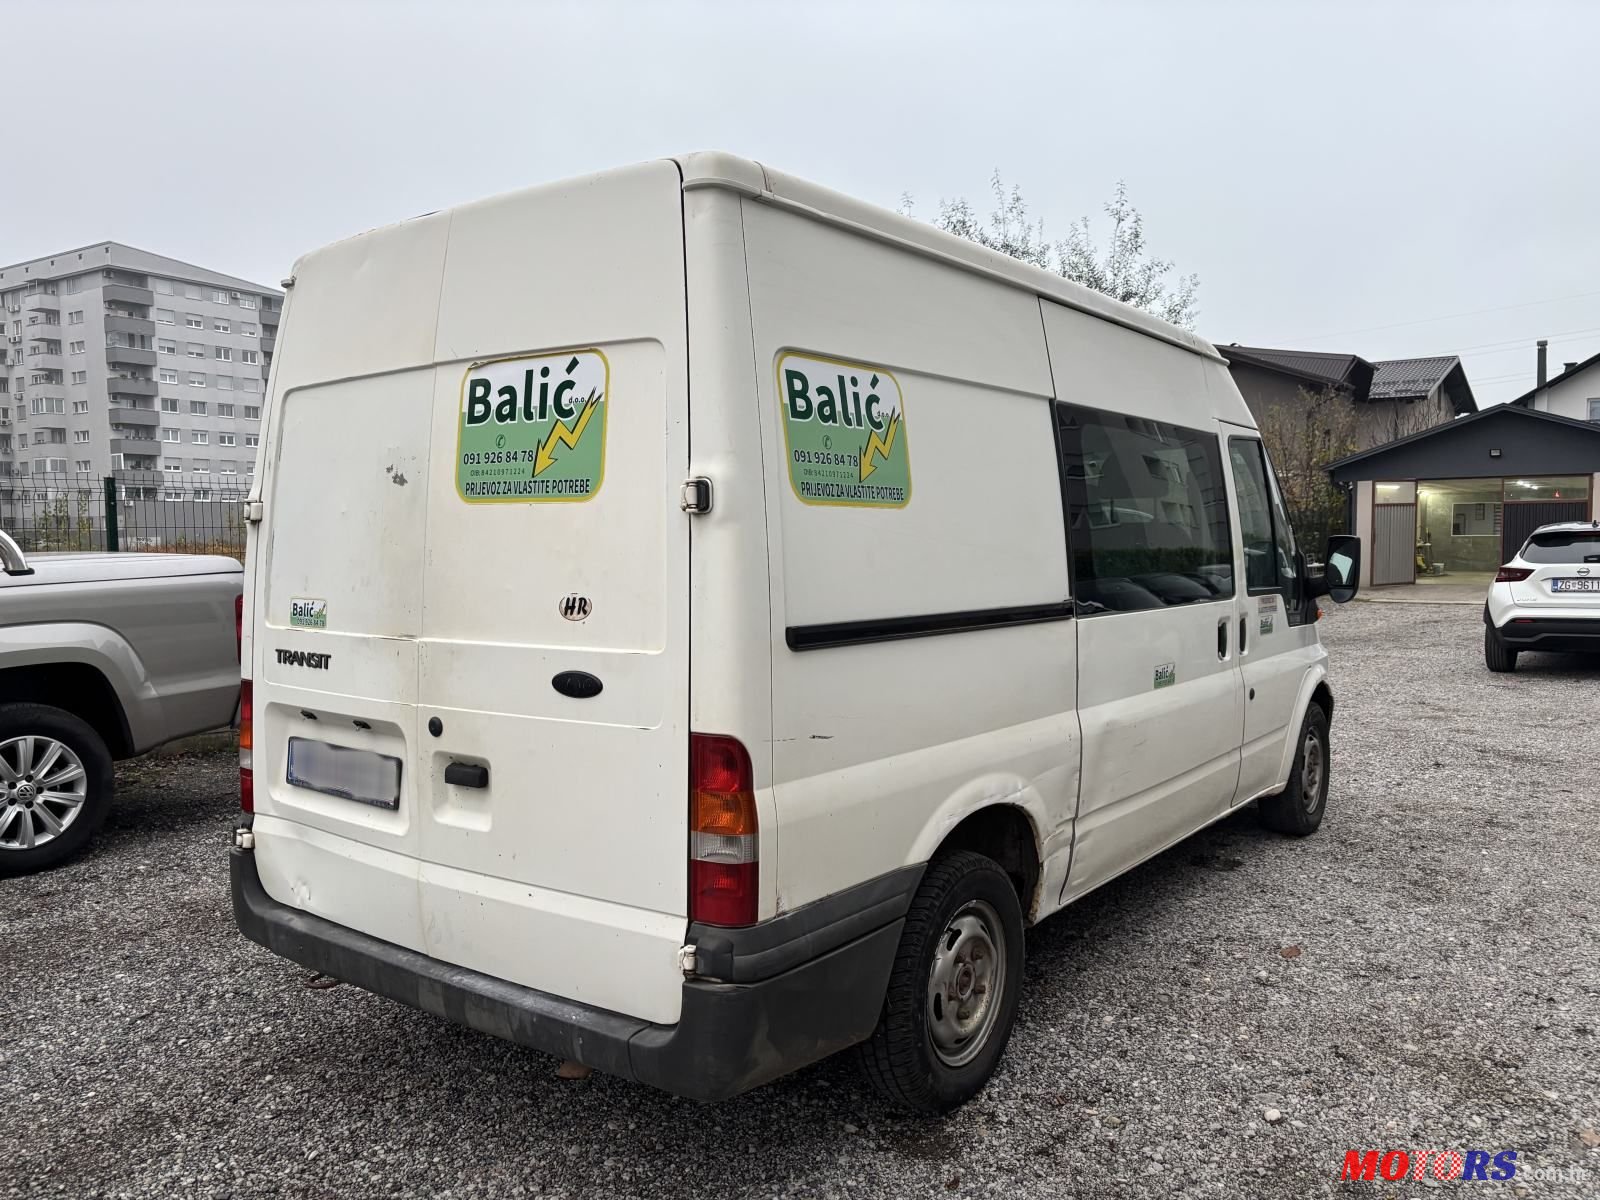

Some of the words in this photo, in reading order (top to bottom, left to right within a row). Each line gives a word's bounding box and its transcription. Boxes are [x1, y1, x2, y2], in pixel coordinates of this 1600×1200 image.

[467, 356, 580, 425] Balić
[785, 368, 884, 431] Balić
[463, 452, 481, 465] 091
[484, 451, 503, 464] 926
[505, 450, 518, 463] 84
[521, 449, 534, 462] 78
[794, 449, 812, 463] 091
[814, 452, 832, 465] 926
[834, 453, 845, 466] 84
[847, 455, 859, 467] 78
[465, 481, 502, 495] PRIJEVOZ
[502, 481, 512, 495] ZA
[513, 480, 550, 494] VLASTITE
[552, 479, 591, 493] POTREBE
[801, 482, 835, 497] PRIJEVOZ
[836, 484, 845, 498] ZA
[844, 484, 876, 499] VLASTITE
[876, 487, 904, 500] POTREBE
[1559, 580, 1571, 590] ZG
[292, 601, 314, 618] Balić
[564, 596, 588, 616] HR
[275, 648, 331, 670] TRANSIT
